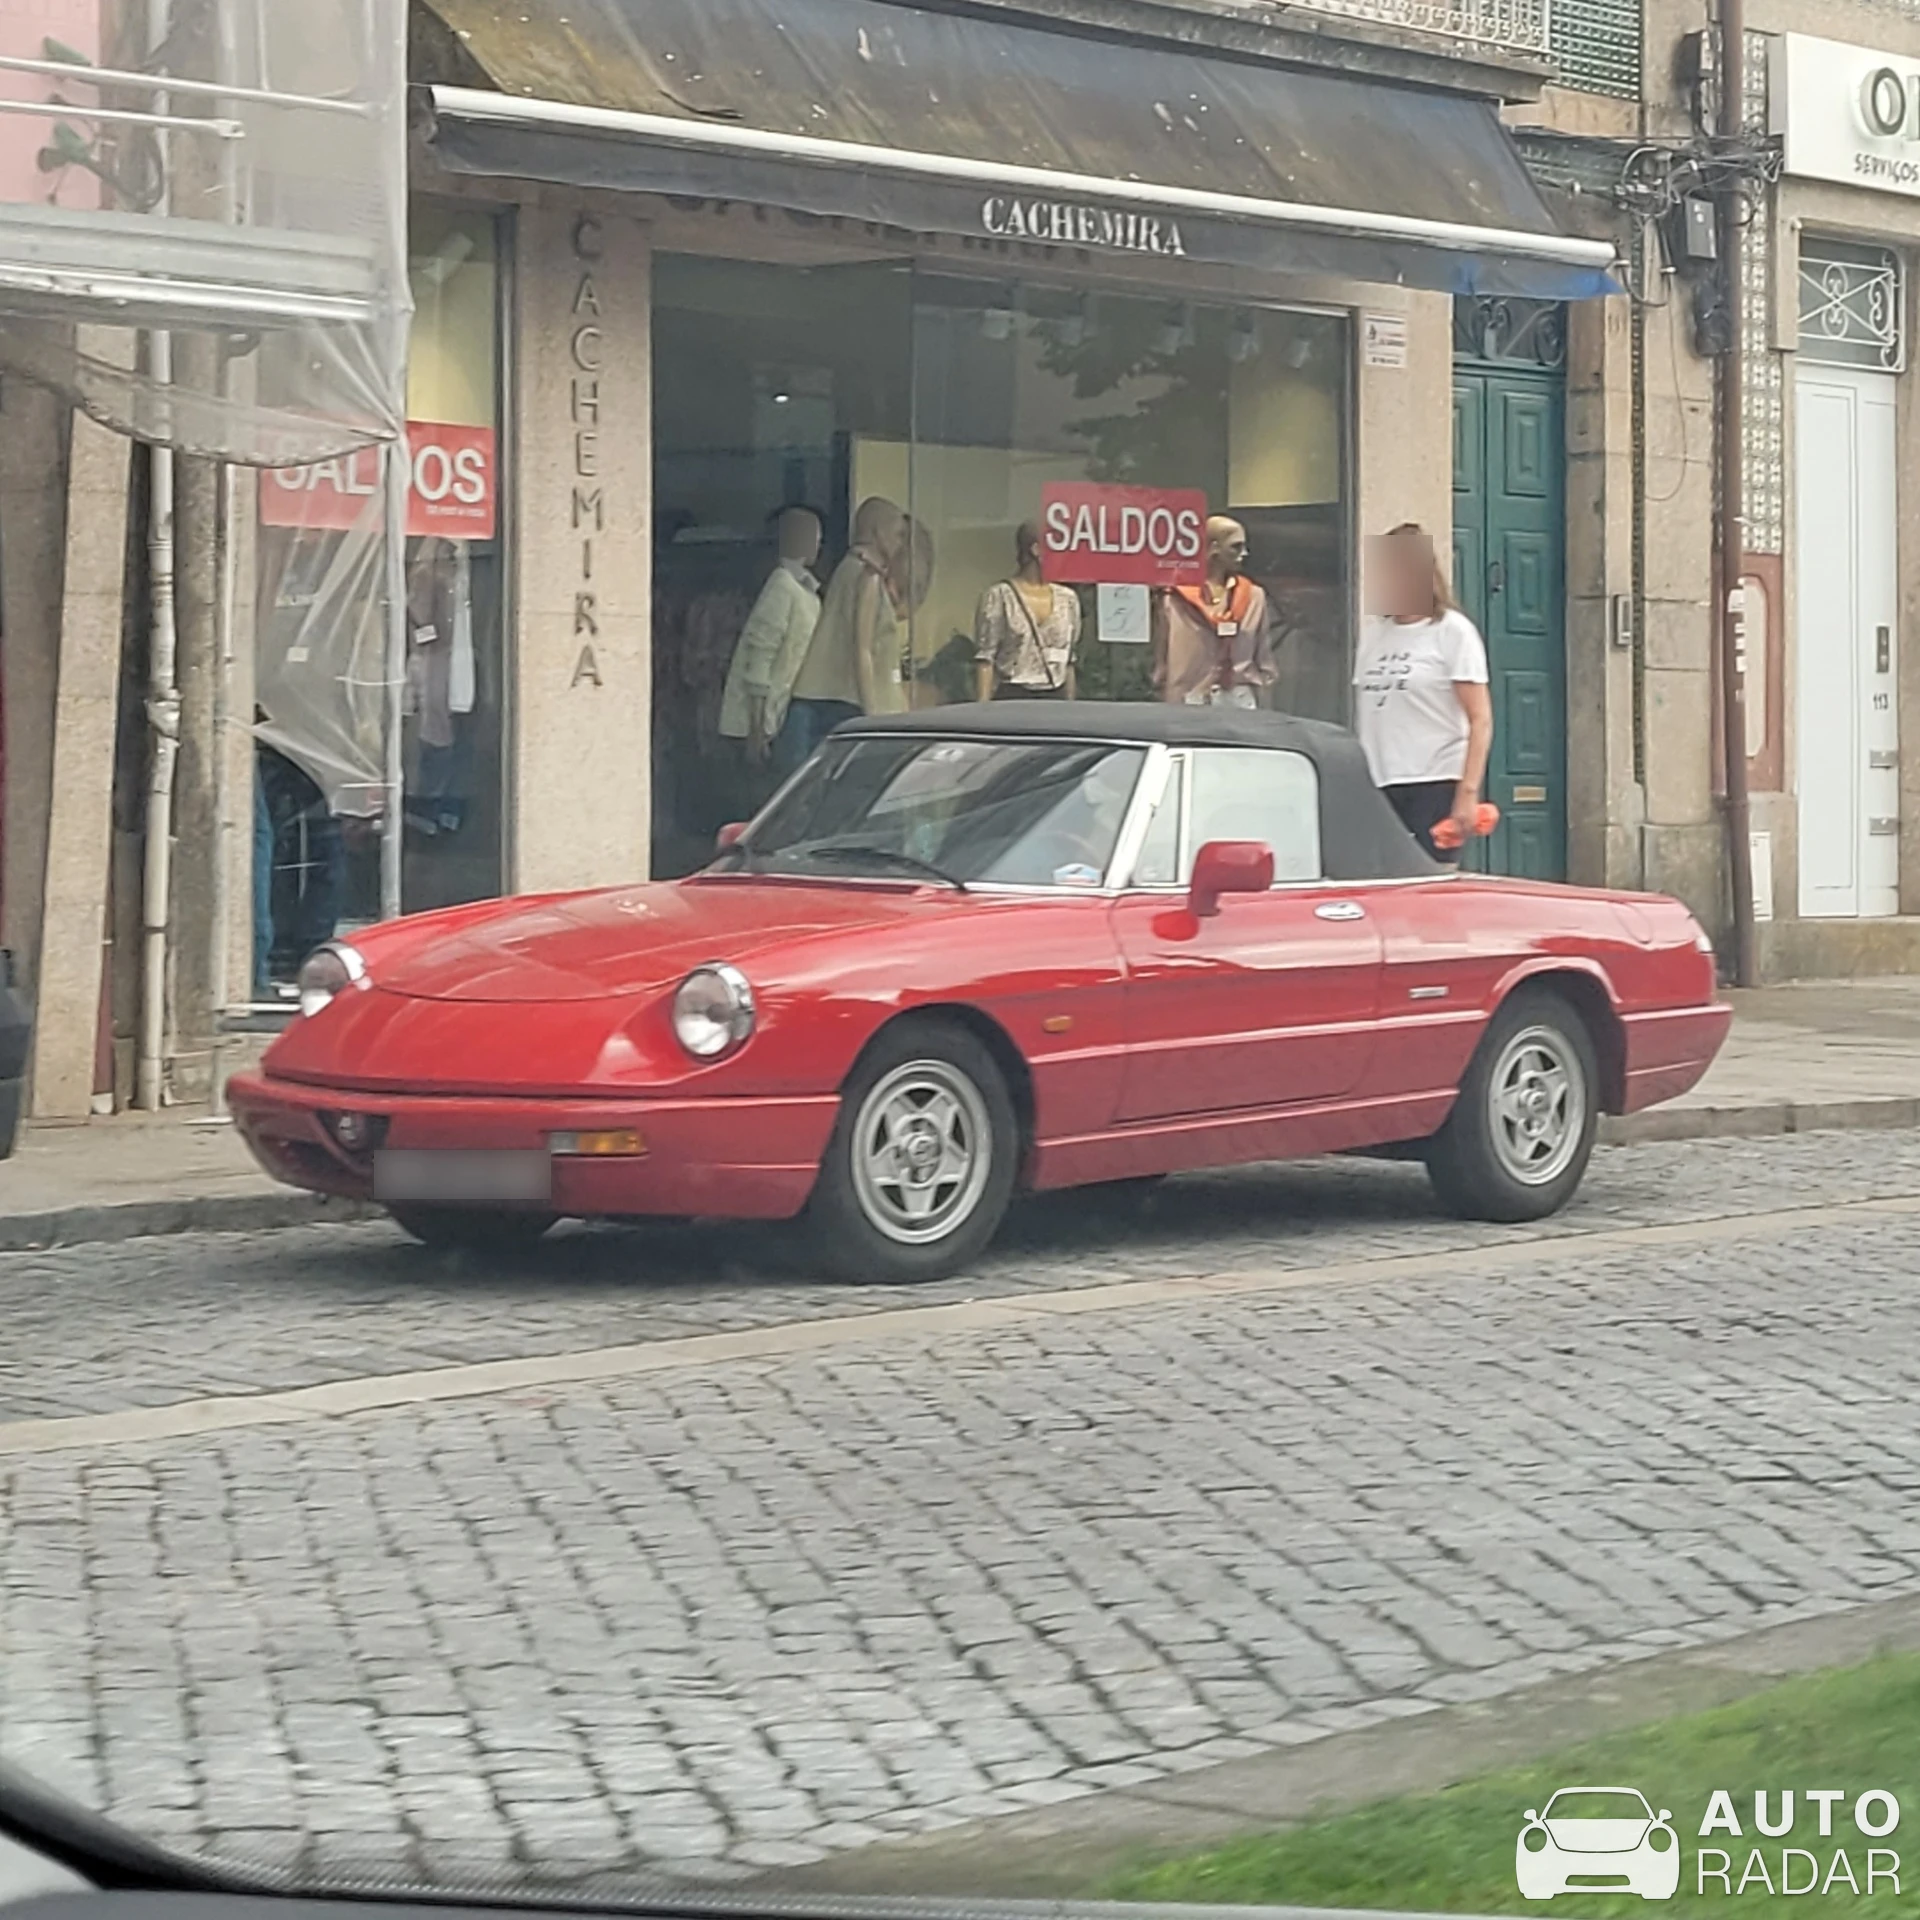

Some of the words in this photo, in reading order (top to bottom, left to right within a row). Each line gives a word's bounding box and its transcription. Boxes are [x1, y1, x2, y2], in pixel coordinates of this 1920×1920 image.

[1860, 67, 1920, 141] O
[1854, 152, 1920, 183] SERVIÇOS
[982, 197, 1187, 256] CACHEMIRA
[571, 217, 604, 688] CACHEMIRA
[1046, 502, 1200, 558] SALDOS
